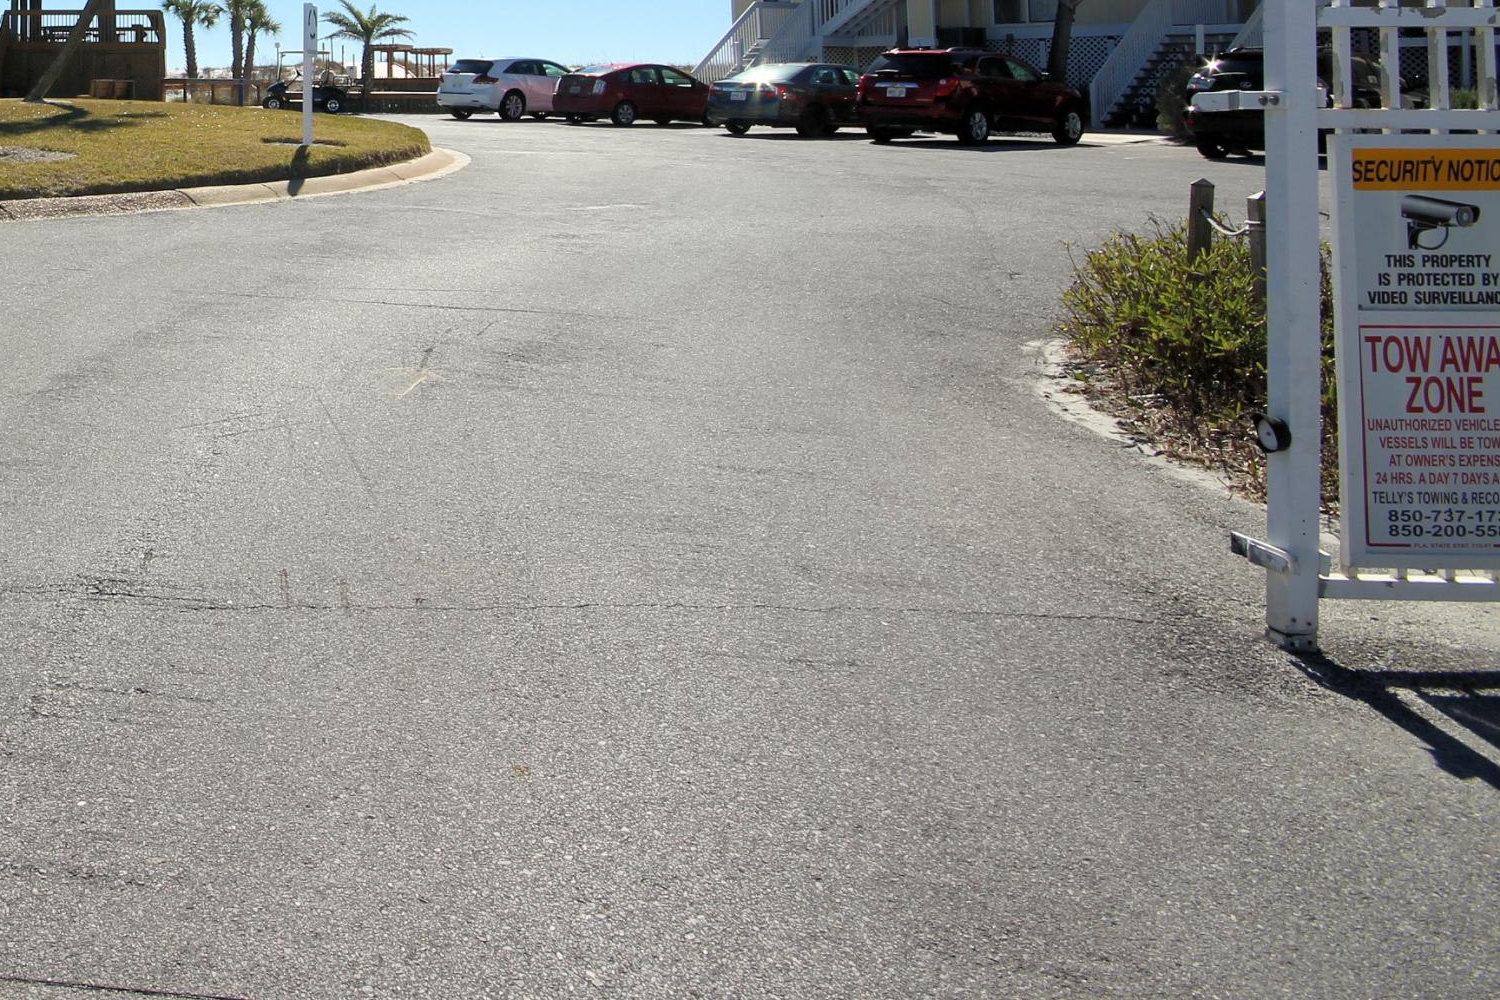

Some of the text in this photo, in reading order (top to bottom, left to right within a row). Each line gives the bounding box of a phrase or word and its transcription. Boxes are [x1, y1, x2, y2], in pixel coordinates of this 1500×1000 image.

[1352, 159, 1443, 182] SECURITY
[1385, 254, 1491, 268] THIS PROPERTY
[1378, 273, 1500, 286] IS PROTECTED BY
[1368, 291, 1408, 304] VIDEO
[1364, 335, 1500, 373] TOW AWA
[1405, 376, 1485, 413] ZONE
[1367, 418, 1500, 431] UNAUTHORIZED VEHICLE
[1379, 437, 1428, 449] VESSELS
[1430, 437, 1457, 449] WILL
[1459, 437, 1474, 449] BE
[1389, 454, 1402, 466] AT
[1405, 454, 1456, 467] OWNER'S
[1376, 472, 1500, 485] 24 HRS. A DAY 7 DAYS A
[1372, 491, 1414, 504] TELLY'S
[1417, 491, 1458, 504] TOWING
[1461, 491, 1469, 504] &
[1389, 524, 1500, 537] 850-200-55
